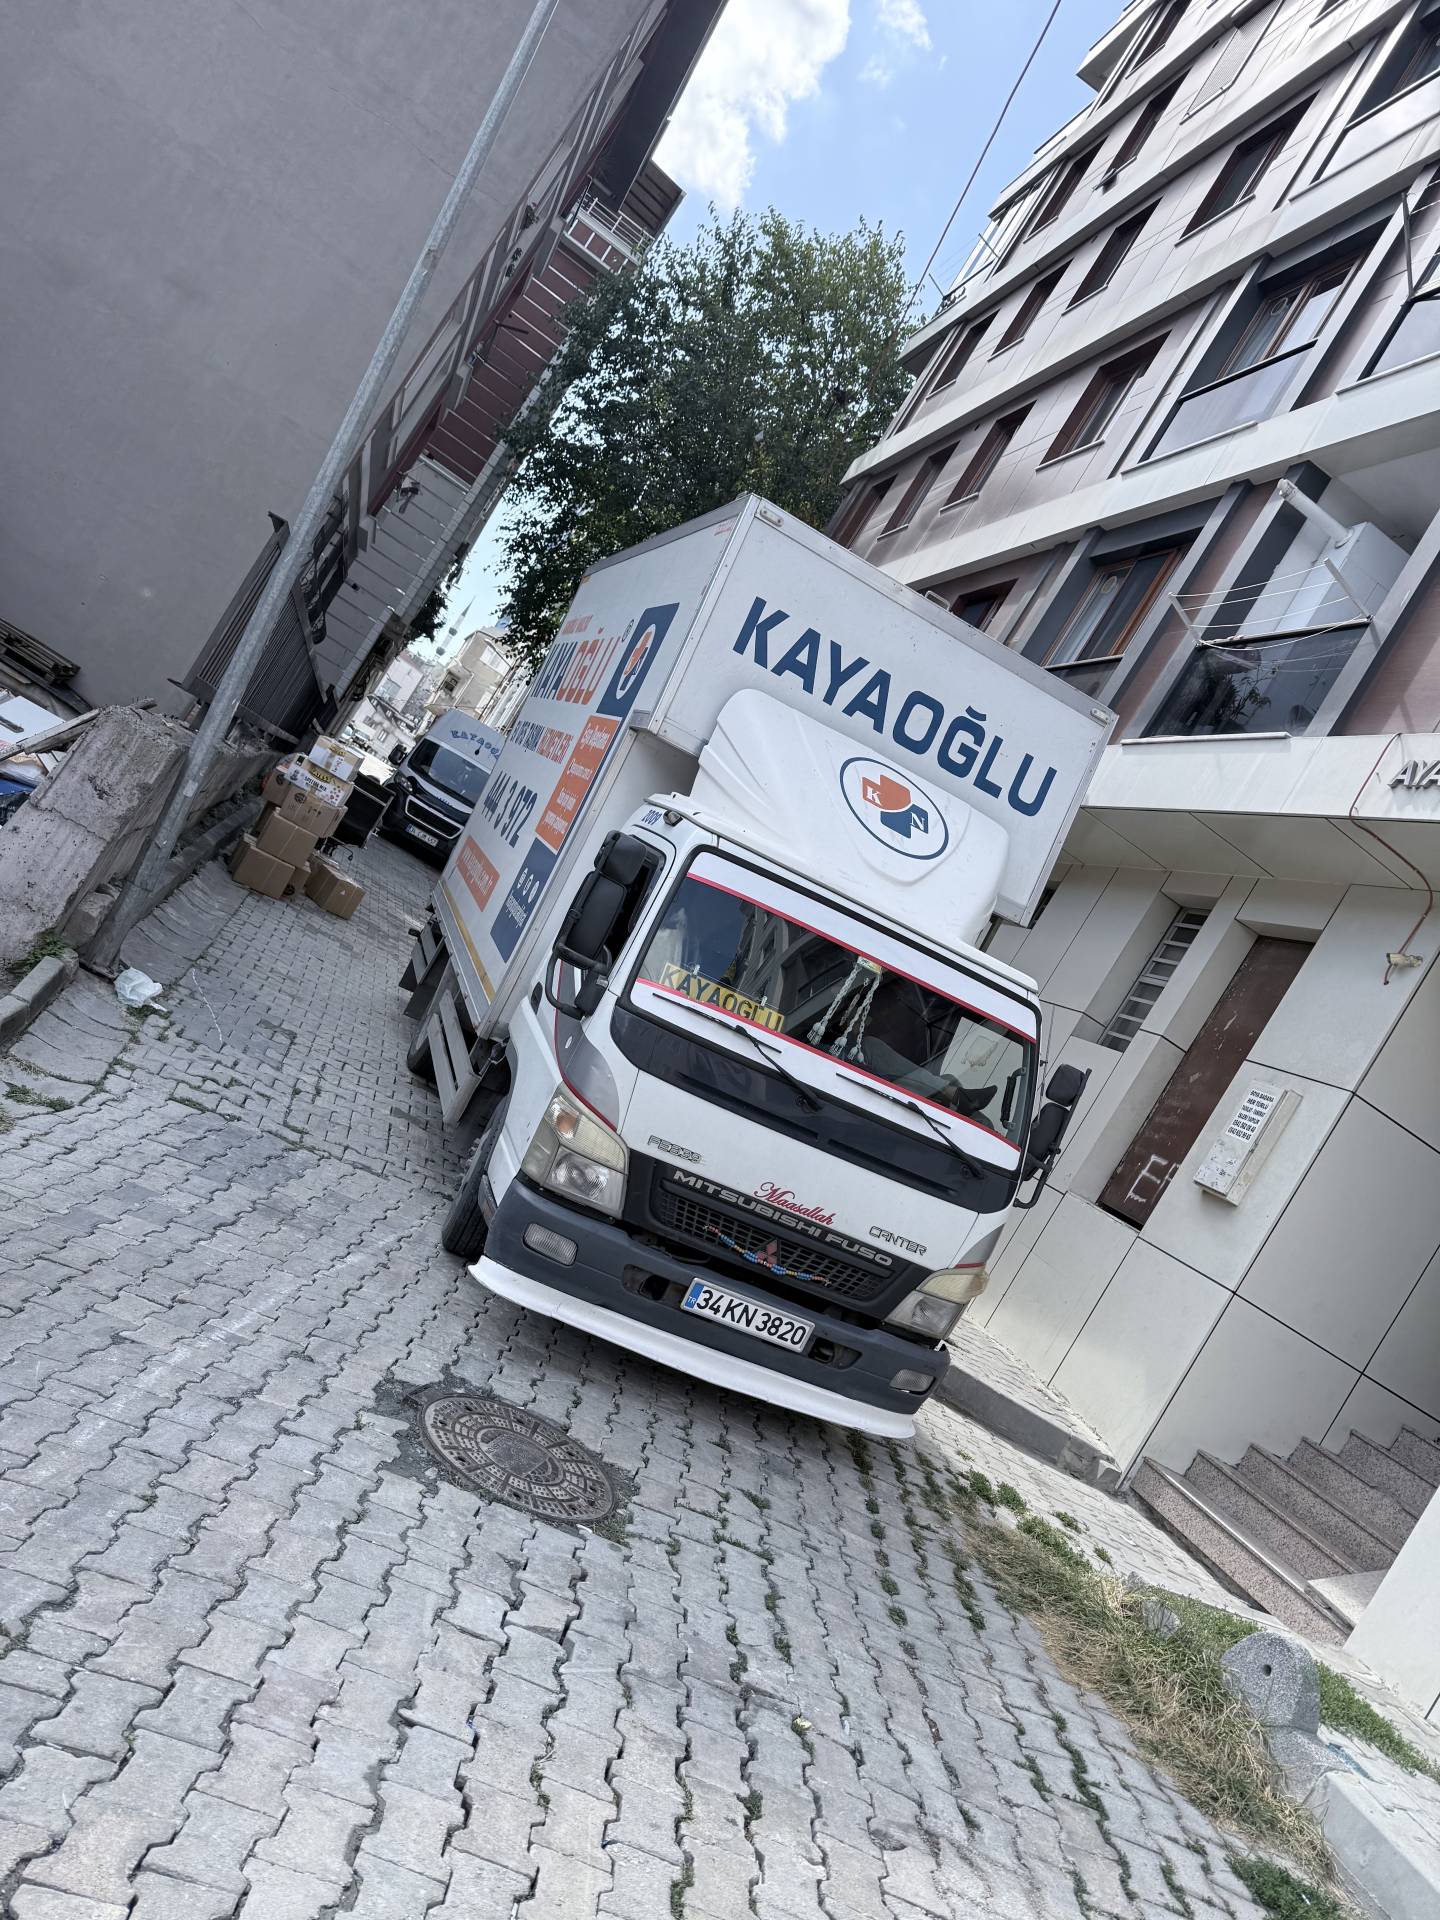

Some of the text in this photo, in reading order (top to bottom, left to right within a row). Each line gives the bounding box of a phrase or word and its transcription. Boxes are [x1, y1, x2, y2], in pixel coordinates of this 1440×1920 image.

[529, 627, 621, 705] KAYAOĞLU
[732, 595, 1057, 817] KAYAOĞLU
[481, 770, 511, 822] 444
[501, 785, 538, 849] 972
[673, 1170, 893, 1267] MITSUBISHI FUSO
[868, 1225, 928, 1257] CANTER
[696, 1289, 807, 1345] 34 KN 3820
